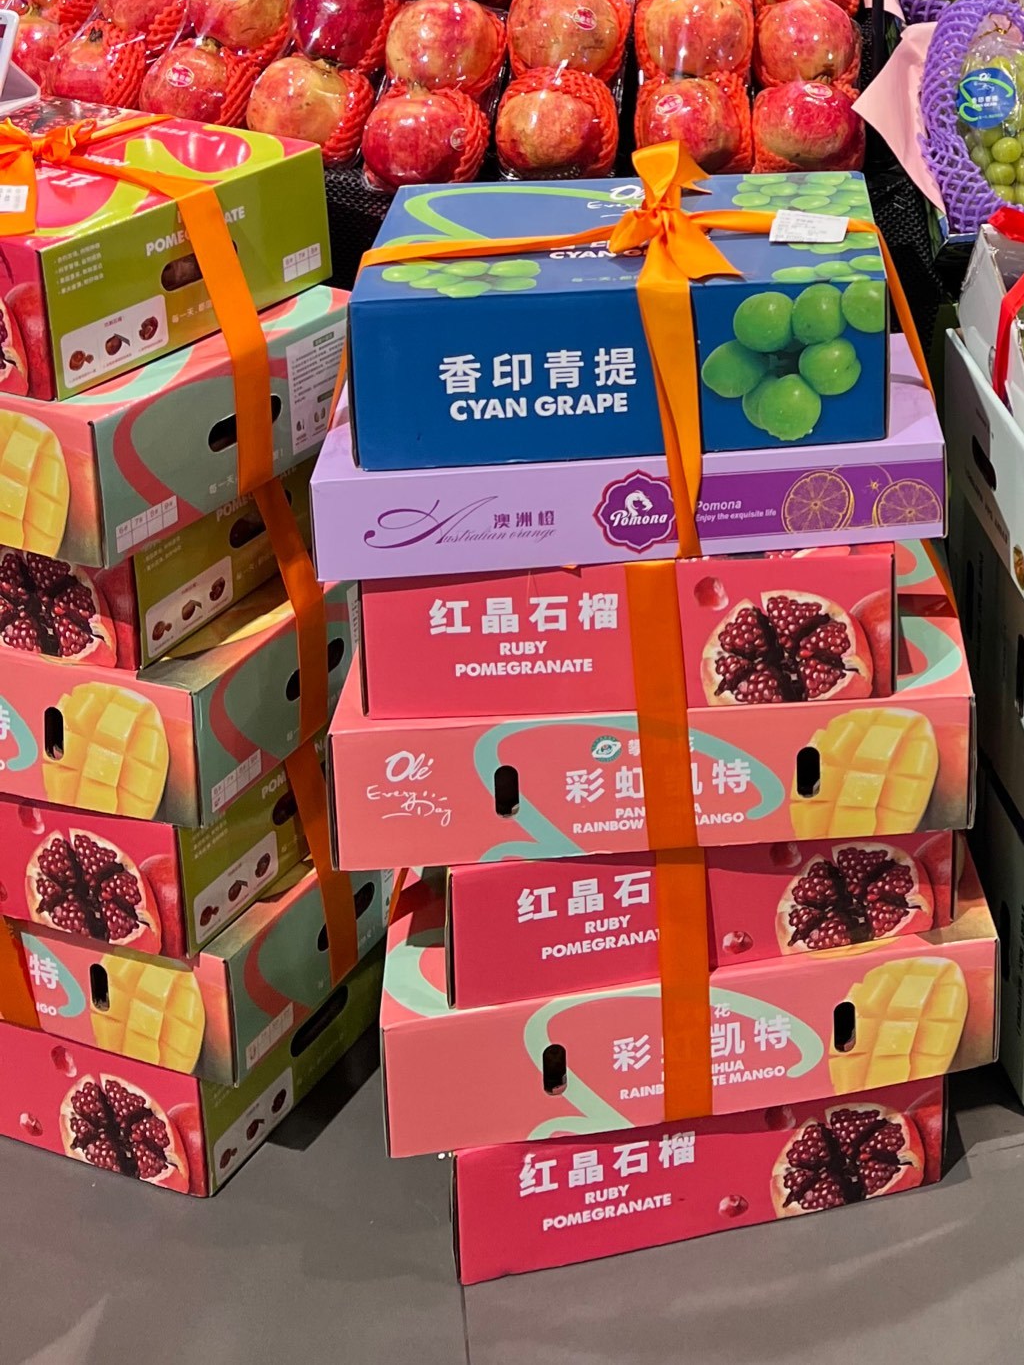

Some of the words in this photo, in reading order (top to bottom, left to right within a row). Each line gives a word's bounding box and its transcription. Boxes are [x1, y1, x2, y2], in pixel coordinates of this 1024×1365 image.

[440, 347, 638, 396] 香印青提
[450, 396, 528, 422] CYAN
[534, 392, 628, 418] GRAPE
[492, 509, 557, 530] 澳洲橙
[610, 507, 668, 528] Pomona
[697, 499, 742, 512] Pomona
[717, 512, 729, 521] the
[730, 510, 763, 522] exquisite
[765, 508, 777, 518] life
[429, 591, 619, 636] 红晶石榴
[500, 640, 548, 656] RUBY
[455, 658, 593, 677] POMEGRANATE
[385, 750, 434, 783] Olé
[367, 785, 416, 811] Every
[410, 799, 453, 827] Day
[572, 819, 644, 834] RAINBOW
[517, 870, 652, 924] 红晶石
[585, 915, 630, 934] RUBY
[541, 928, 660, 959] POMEGRANAT
[613, 1017, 792, 1073] 彩凯特
[620, 1083, 664, 1100] RAINB
[730, 1065, 786, 1084] MANGO
[519, 1130, 696, 1199] 红晶石榴
[584, 1184, 629, 1204] RUBY
[542, 1194, 672, 1232] POMEGRANATE
